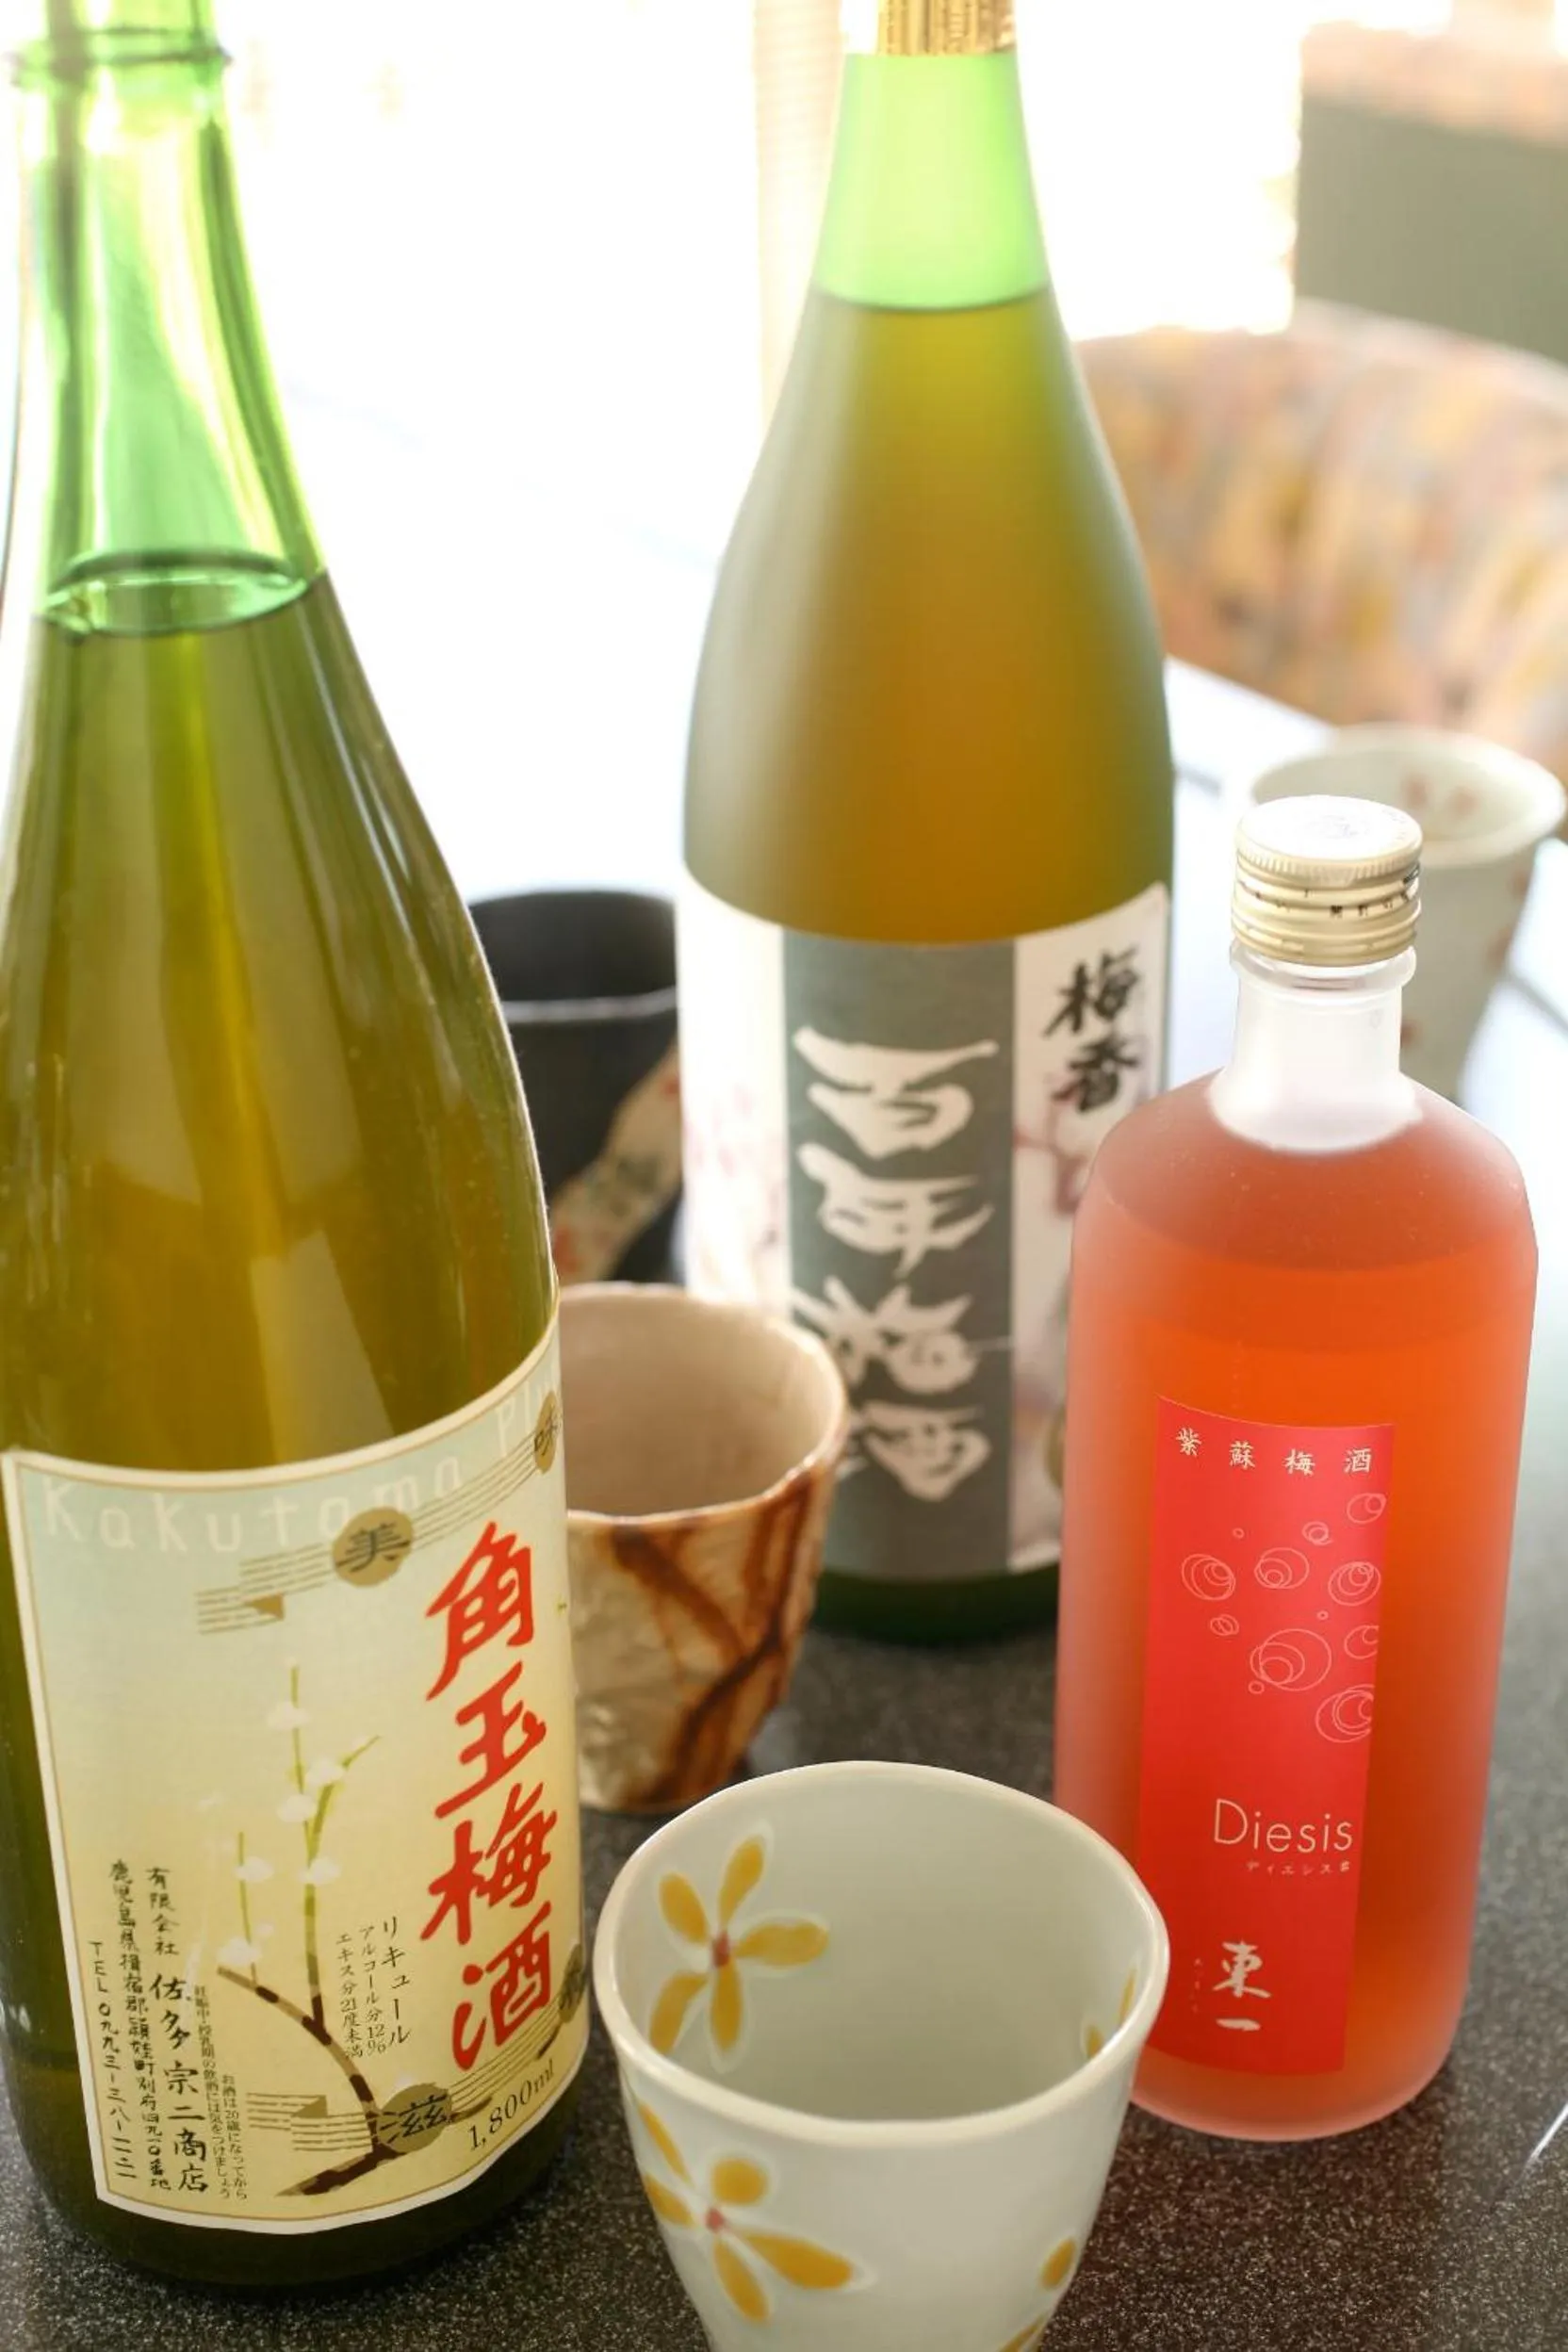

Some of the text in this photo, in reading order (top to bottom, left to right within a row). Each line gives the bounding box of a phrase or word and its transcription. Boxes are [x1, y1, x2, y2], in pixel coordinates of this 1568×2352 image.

[1176, 1428, 1372, 1476] 紫蘇梅酒
[419, 1521, 557, 2071] 角玉梅酒
[1214, 1798, 1353, 1854] Diesis
[382, 1916, 412, 2045] リキュール
[468, 2058, 555, 2151] 1,800ml
